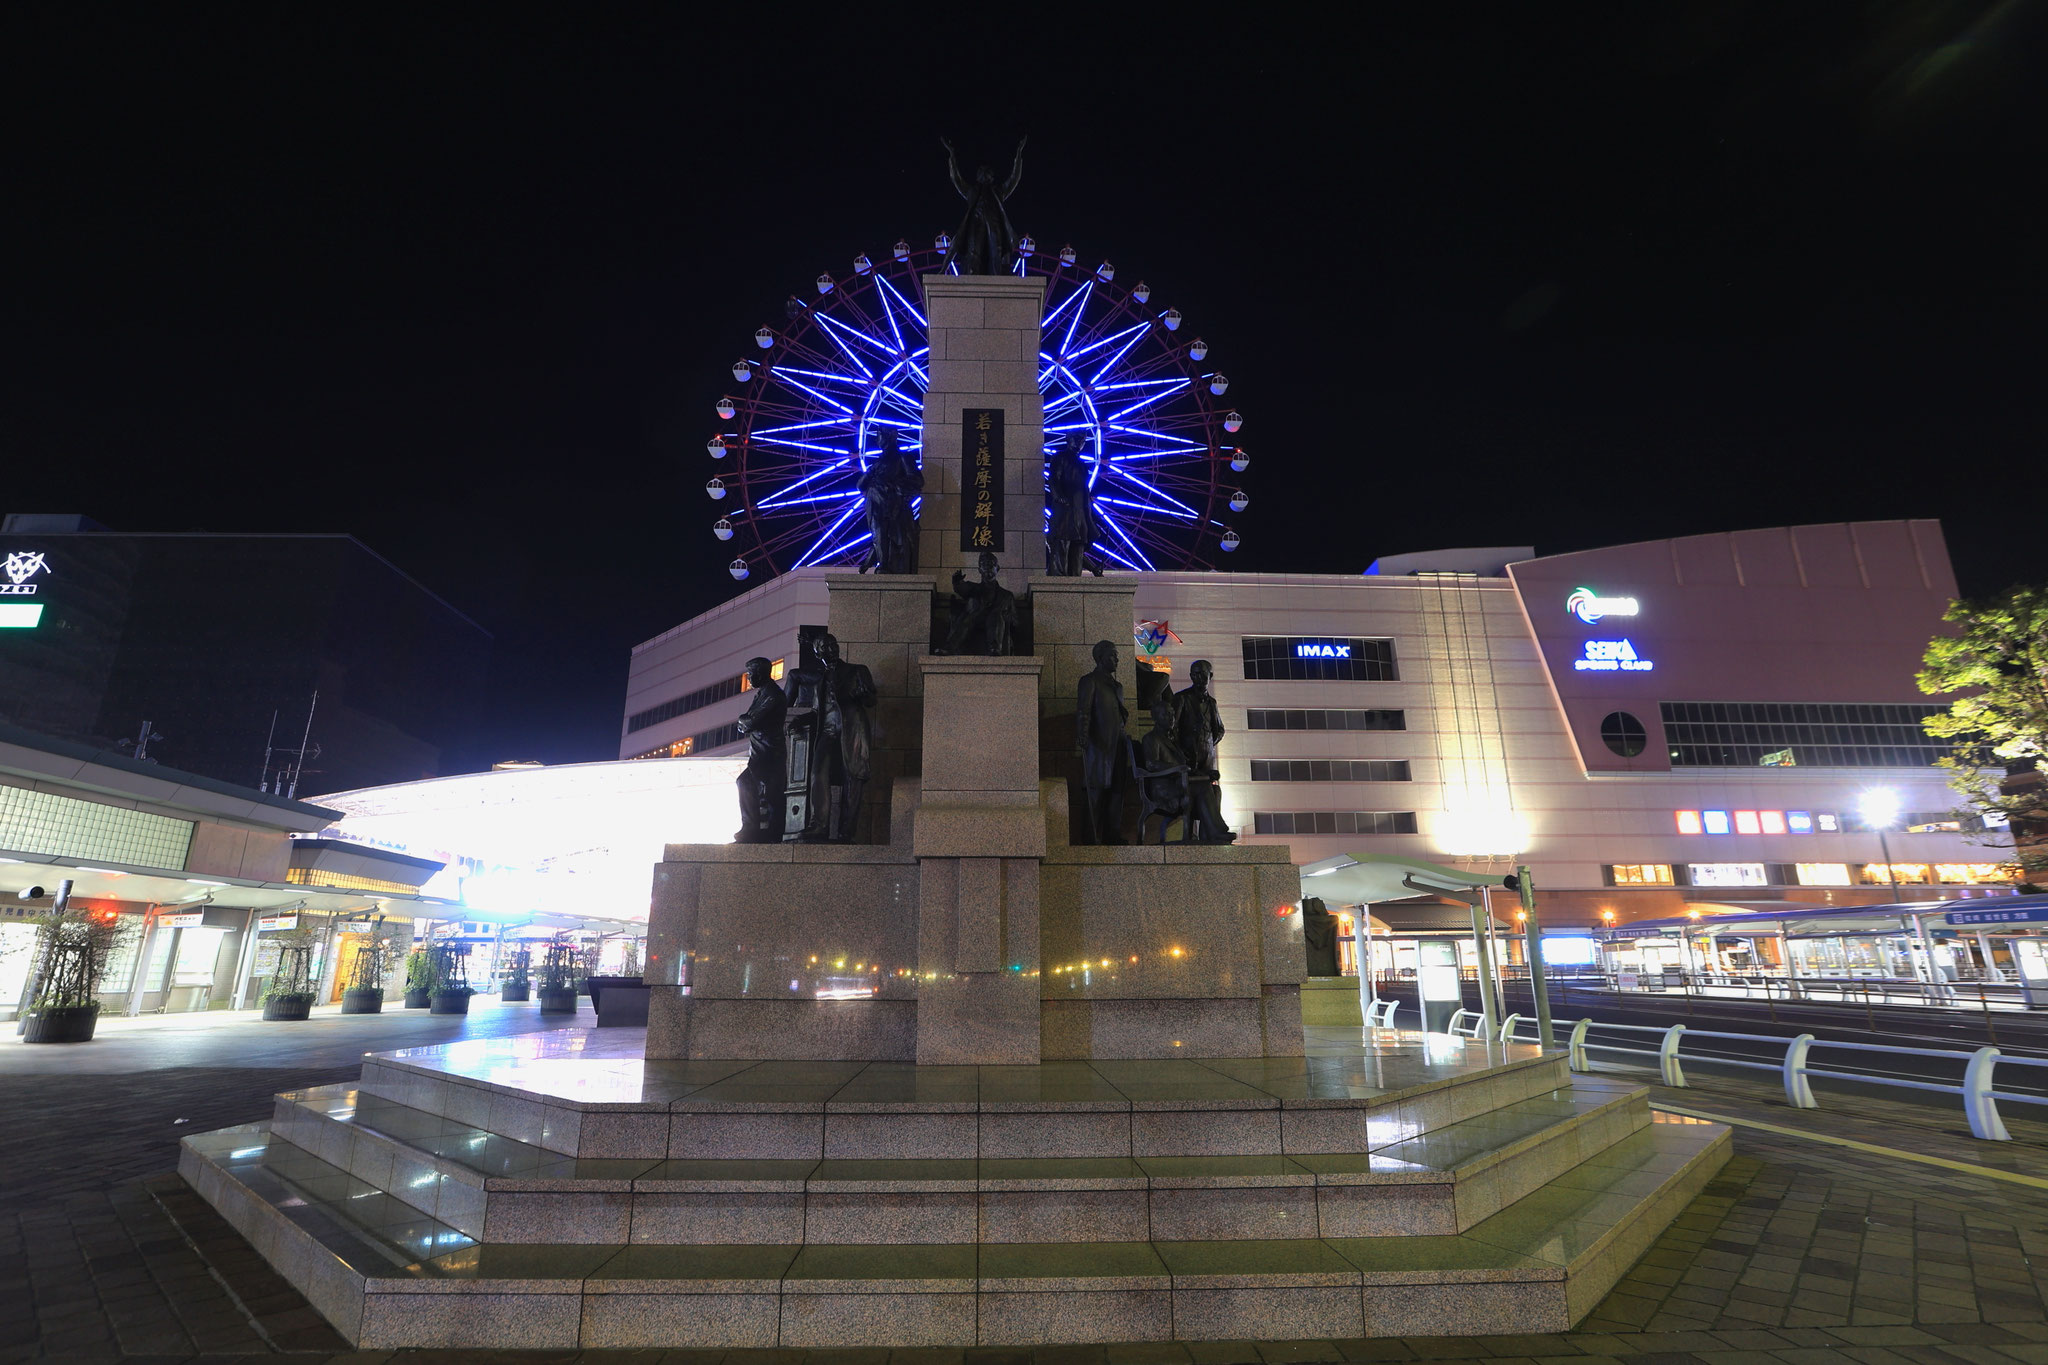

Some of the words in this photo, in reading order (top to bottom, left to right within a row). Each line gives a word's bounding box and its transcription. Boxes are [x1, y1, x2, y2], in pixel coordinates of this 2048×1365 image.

[972, 413, 994, 546] 若き薩摩の群像
[1297, 645, 1350, 657] IMAX
